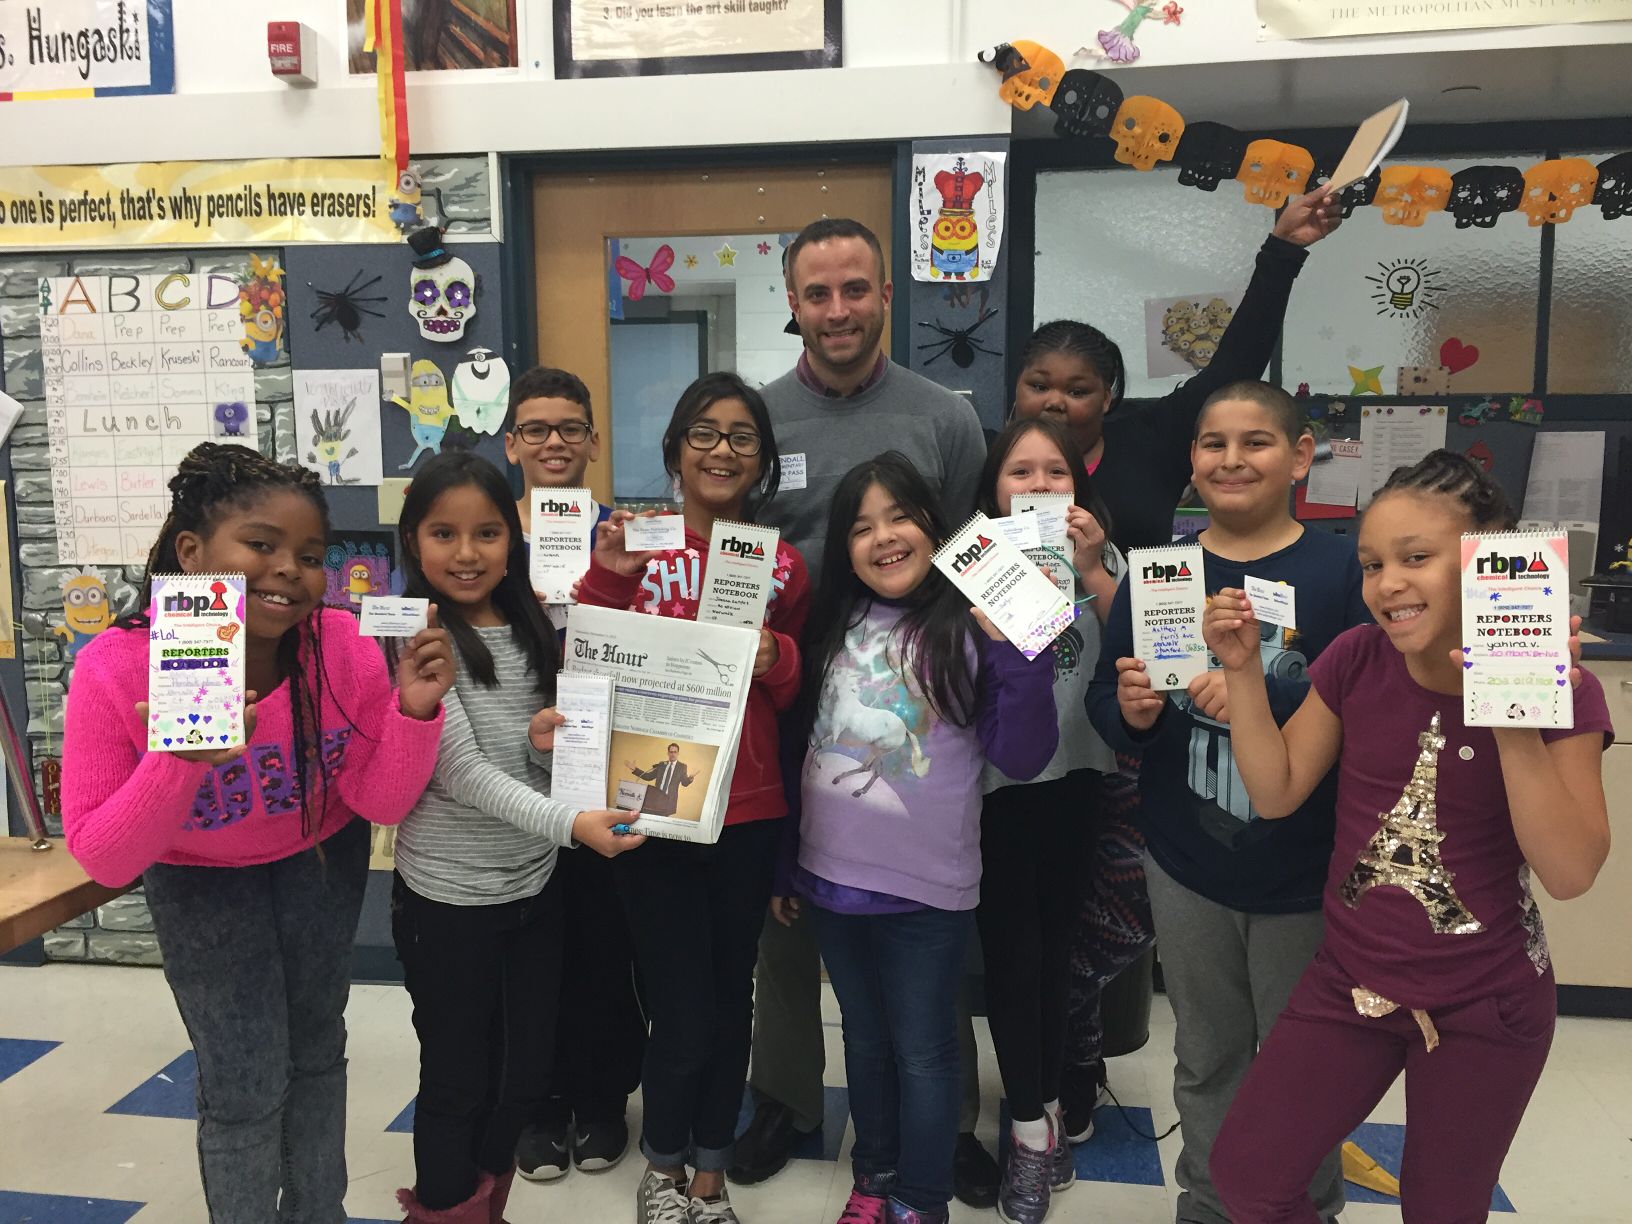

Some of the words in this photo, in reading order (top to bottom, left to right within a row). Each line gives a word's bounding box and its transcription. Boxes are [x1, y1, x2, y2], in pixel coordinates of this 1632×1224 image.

[635, 7, 654, 21] you
[686, 3, 703, 15] the
[706, 3, 722, 14] art
[724, 1, 746, 13] skill
[749, 0, 789, 14] taught?
[1329, 7, 1360, 20] THE
[1367, 1, 1495, 18] METROPOLITAN
[27, 1, 141, 80] Hungaski
[270, 43, 293, 53] FIRE
[10, 198, 37, 225] one
[38, 190, 55, 224] is
[58, 189, 117, 231] perfect,
[120, 187, 166, 221] that's
[168, 186, 202, 228] why
[207, 183, 263, 227] pencils
[266, 183, 306, 217] have
[310, 184, 376, 219] erasers!
[59, 275, 97, 316] A
[108, 275, 142, 313] B
[154, 273, 192, 311] C
[206, 274, 241, 310] D
[113, 313, 144, 340] Prep
[159, 313, 187, 340] Prep
[207, 311, 237, 335] Prep
[61, 347, 104, 374] Collins
[110, 350, 155, 376] Beckley
[82, 406, 182, 433] Lunch
[541, 499, 570, 517] rbp
[720, 536, 754, 559] rbp
[951, 541, 982, 575] rbp
[1142, 562, 1178, 583] rbp
[1477, 551, 1528, 580] rbp
[1518, 573, 1550, 581] technology
[712, 587, 759, 600] NOTEBOOK
[713, 578, 761, 591] REPORTERS
[980, 562, 1021, 601] REPORTERS
[988, 569, 1028, 608] NOTEBOOK
[164, 591, 211, 618] rbp
[1144, 607, 1196, 617] REPORTERS
[1144, 616, 1196, 627] NOTEBOOK
[1477, 614, 1553, 624] REPORTERS
[1477, 627, 1553, 637] NOTEBOOK
[161, 647, 230, 658] REPORTERS
[574, 637, 599, 661] The
[600, 643, 649, 668] Hour
[621, 674, 637, 684] now
[639, 678, 677, 691] projected
[677, 681, 686, 691] at
[686, 683, 705, 695] $600
[705, 687, 732, 699] million
